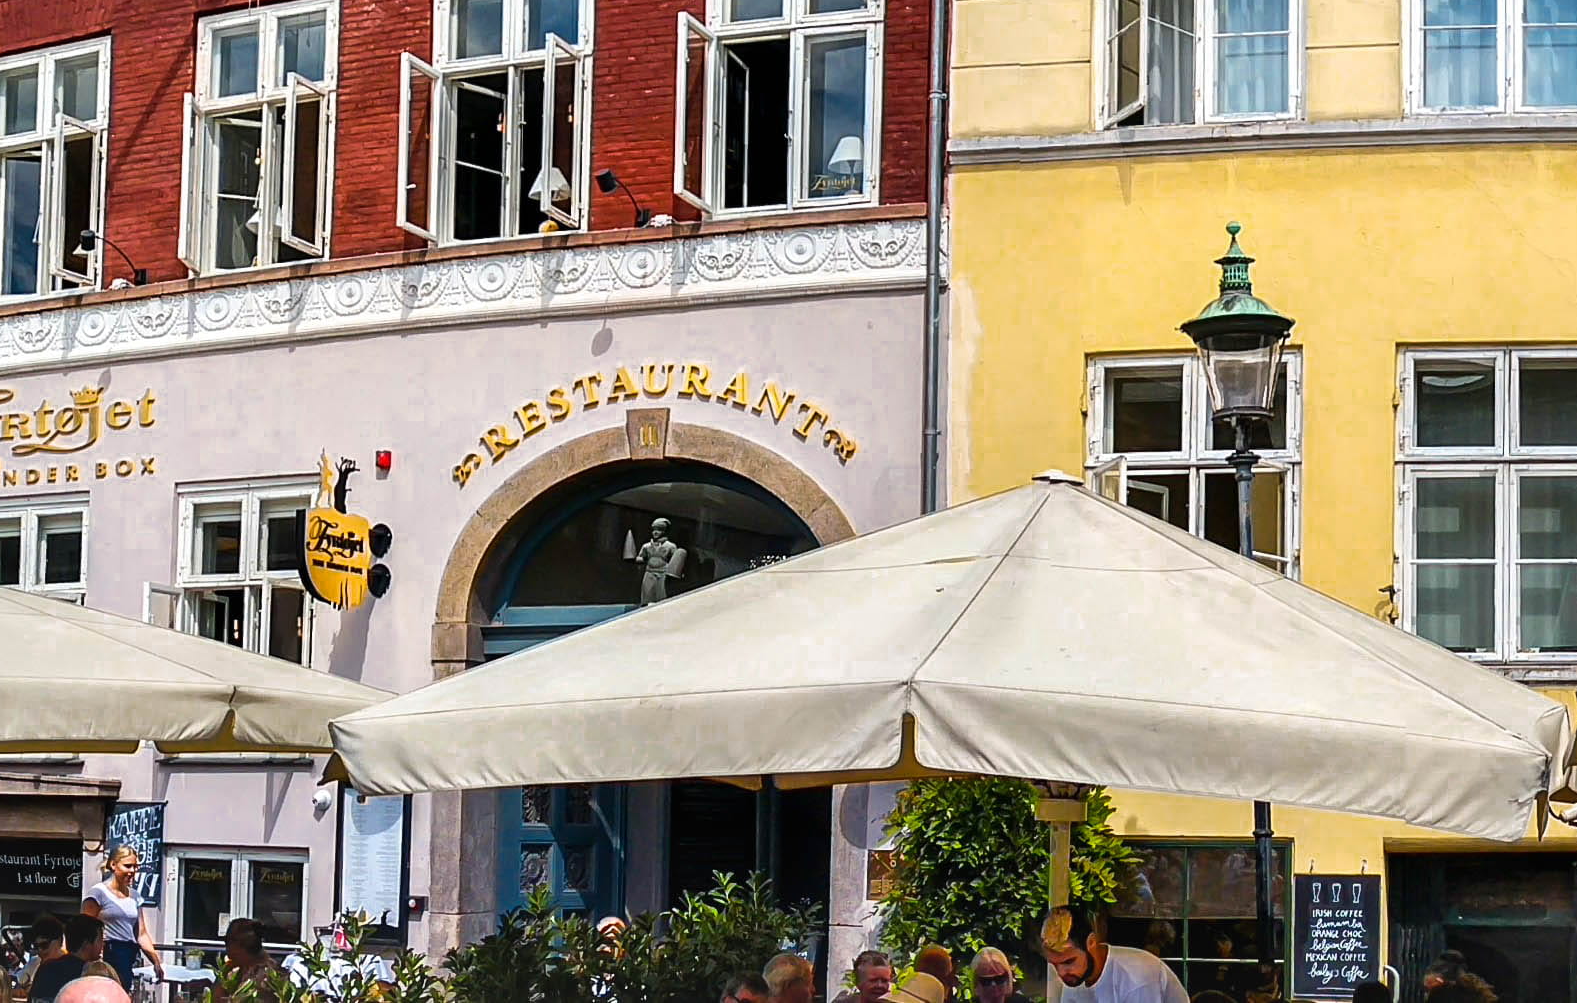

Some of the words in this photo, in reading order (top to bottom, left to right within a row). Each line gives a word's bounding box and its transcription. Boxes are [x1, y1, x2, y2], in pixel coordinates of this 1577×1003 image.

[480, 363, 829, 464] RESTAURANT
[95, 458, 155, 478] BOX
[109, 805, 162, 838] KAFFE
[43, 851, 82, 868] Fyrtøje
[34, 870, 57, 884] floor
[1312, 909, 1332, 917] IRISH
[1335, 909, 1364, 917] COFFEE
[1342, 929, 1364, 938] CHOC
[1305, 953, 1338, 962] MEXICAN
[1339, 953, 1367, 962] COFFEE
